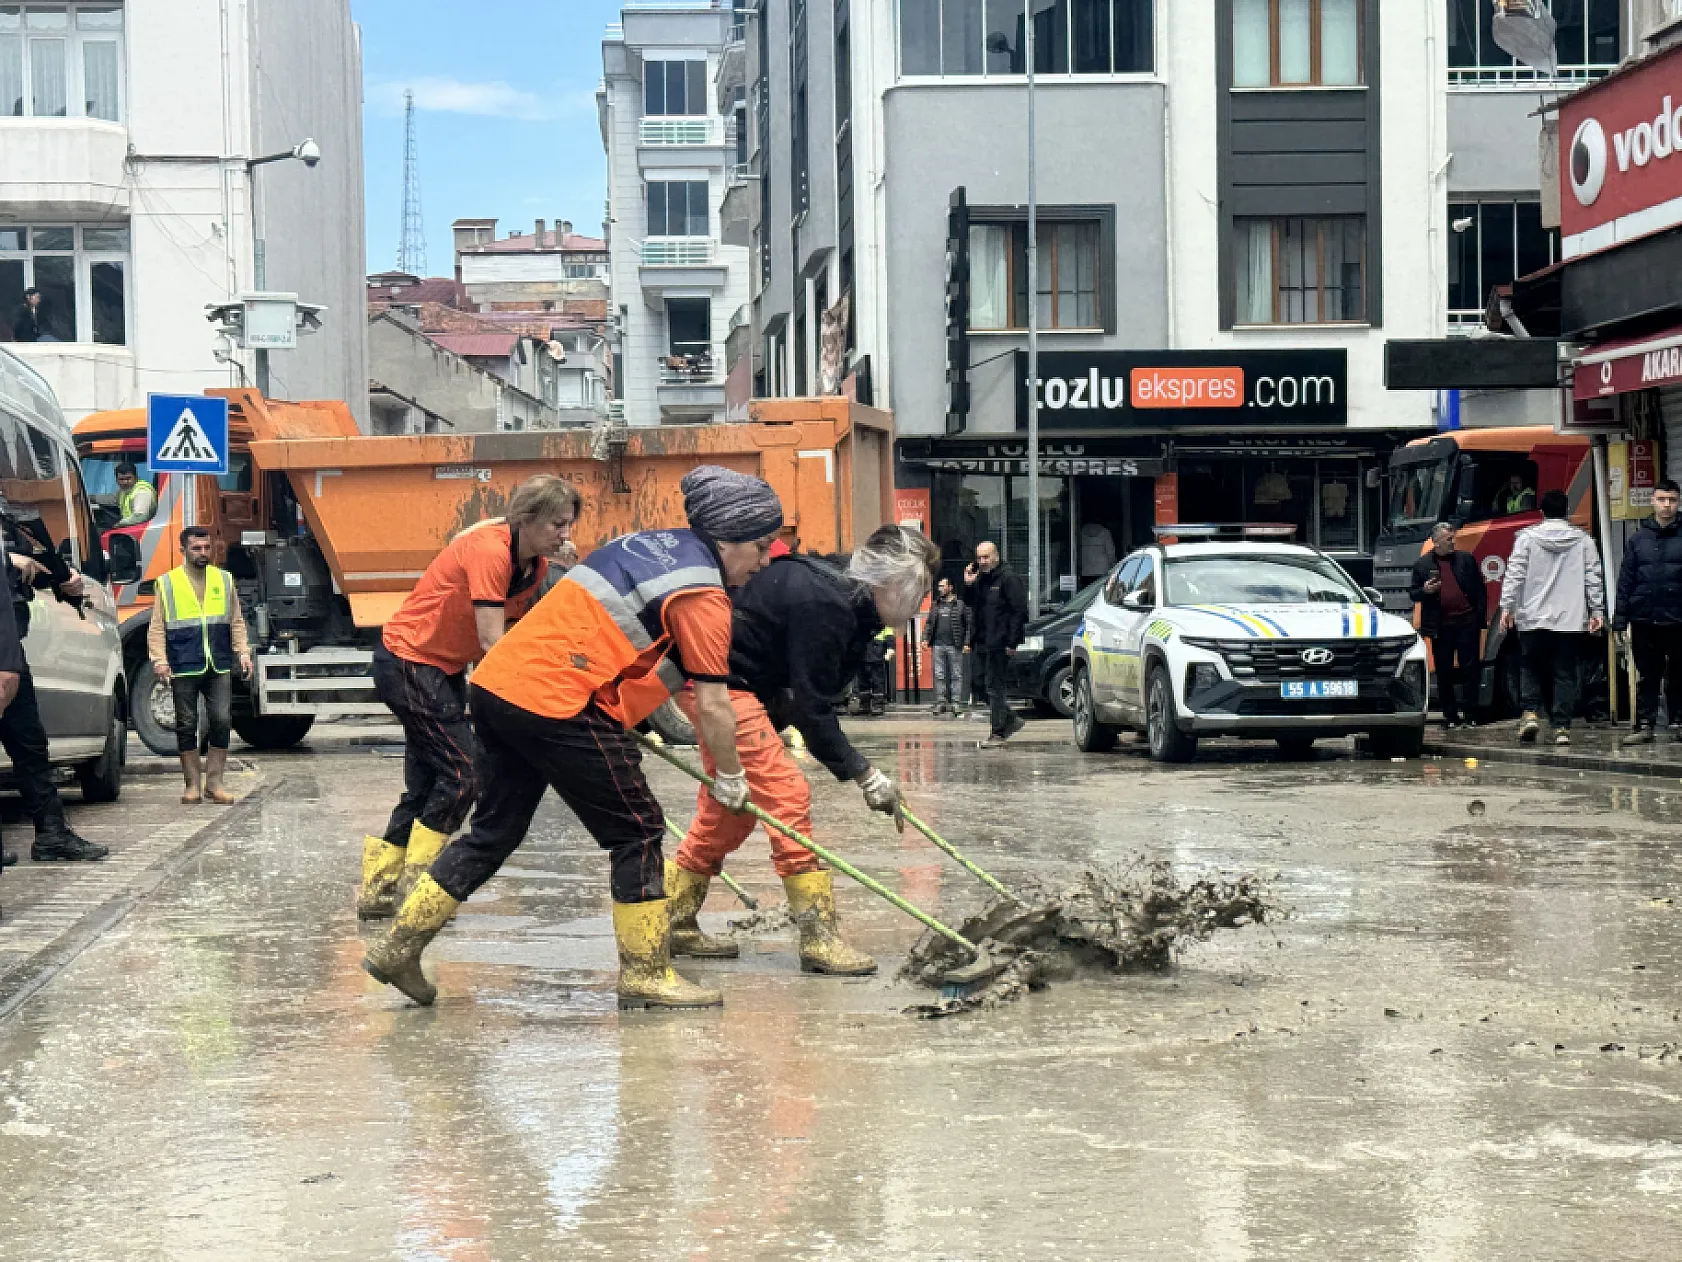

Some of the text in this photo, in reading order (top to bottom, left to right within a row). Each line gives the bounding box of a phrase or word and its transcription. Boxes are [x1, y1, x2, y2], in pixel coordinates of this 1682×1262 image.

[1642, 347, 1682, 382] AKAR
[1138, 372, 1236, 406] ekspres
[1248, 375, 1335, 408] .com
[1309, 681, 1318, 695] A
